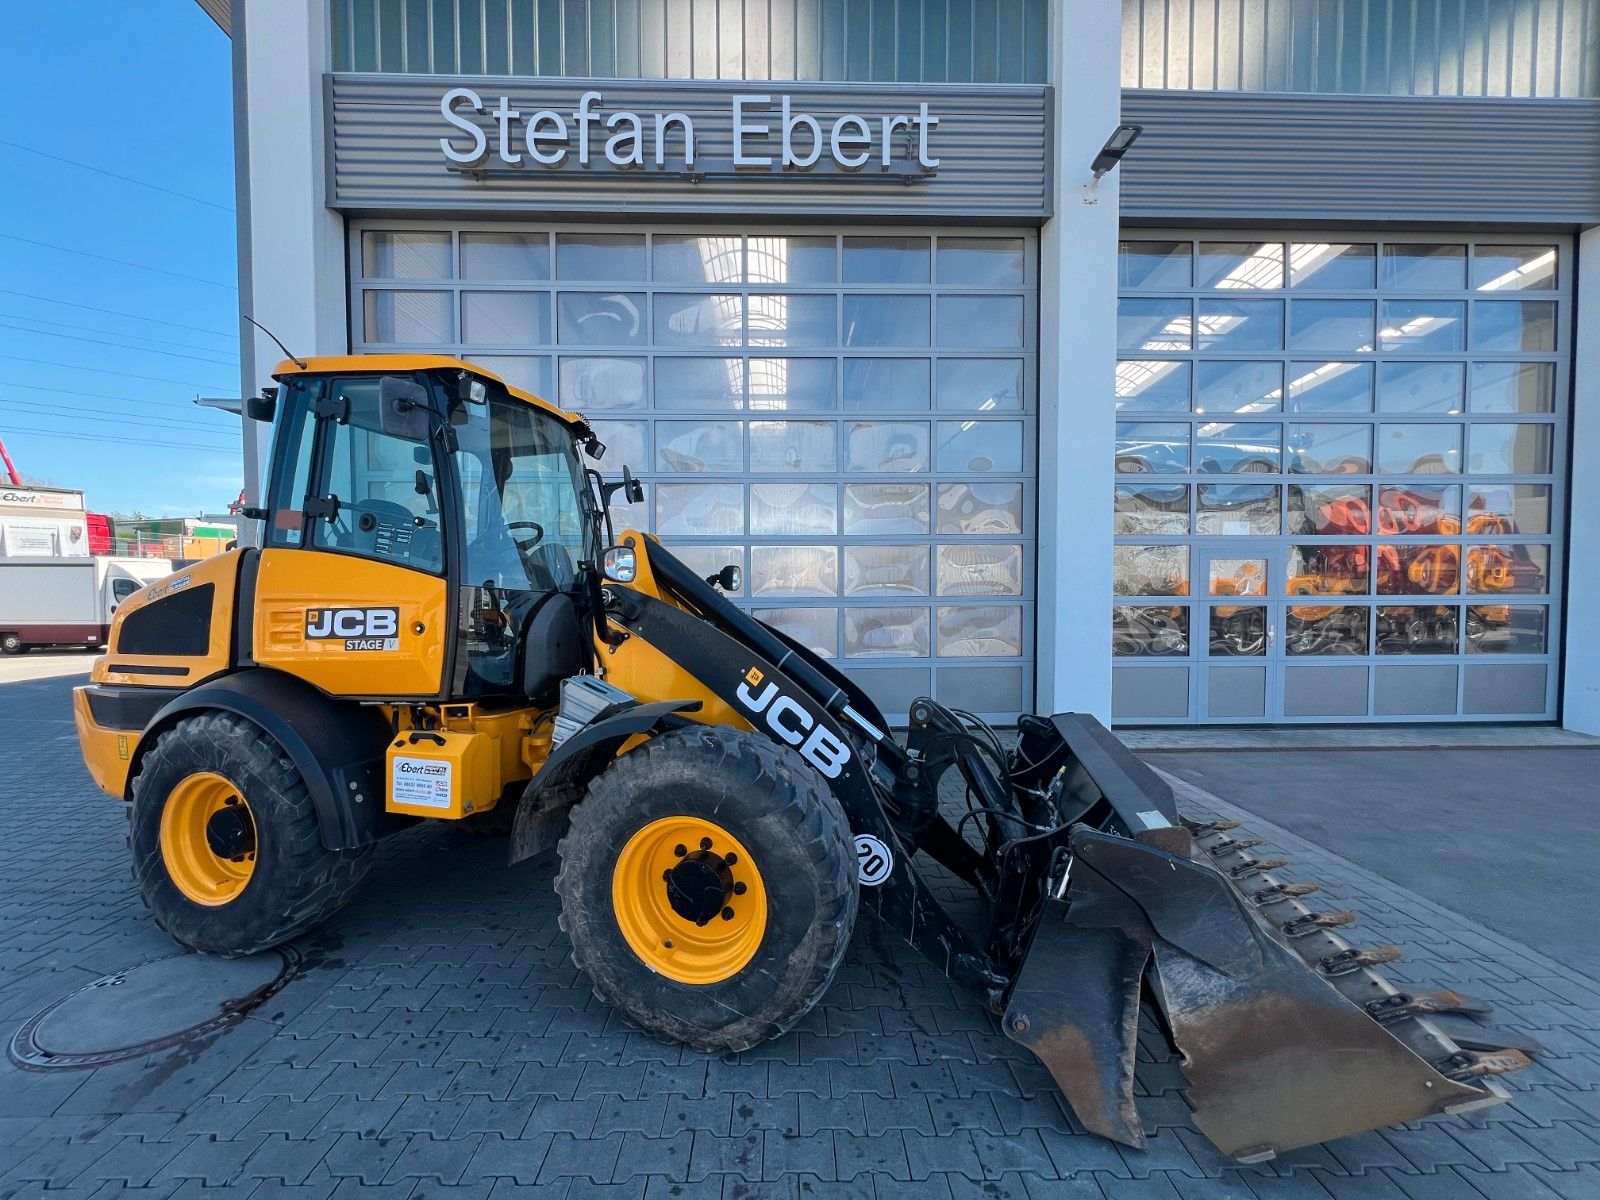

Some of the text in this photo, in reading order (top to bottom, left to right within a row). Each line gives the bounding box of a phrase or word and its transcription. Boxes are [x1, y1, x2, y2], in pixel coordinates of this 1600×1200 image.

[439, 87, 941, 168] Stefan Ebert
[3, 492, 36, 503] Ebert
[307, 609, 397, 637] JCB
[346, 640, 396, 650] STAGE V
[736, 681, 851, 779] JCB
[401, 762, 424, 775] Ebert
[858, 843, 884, 877] 20
